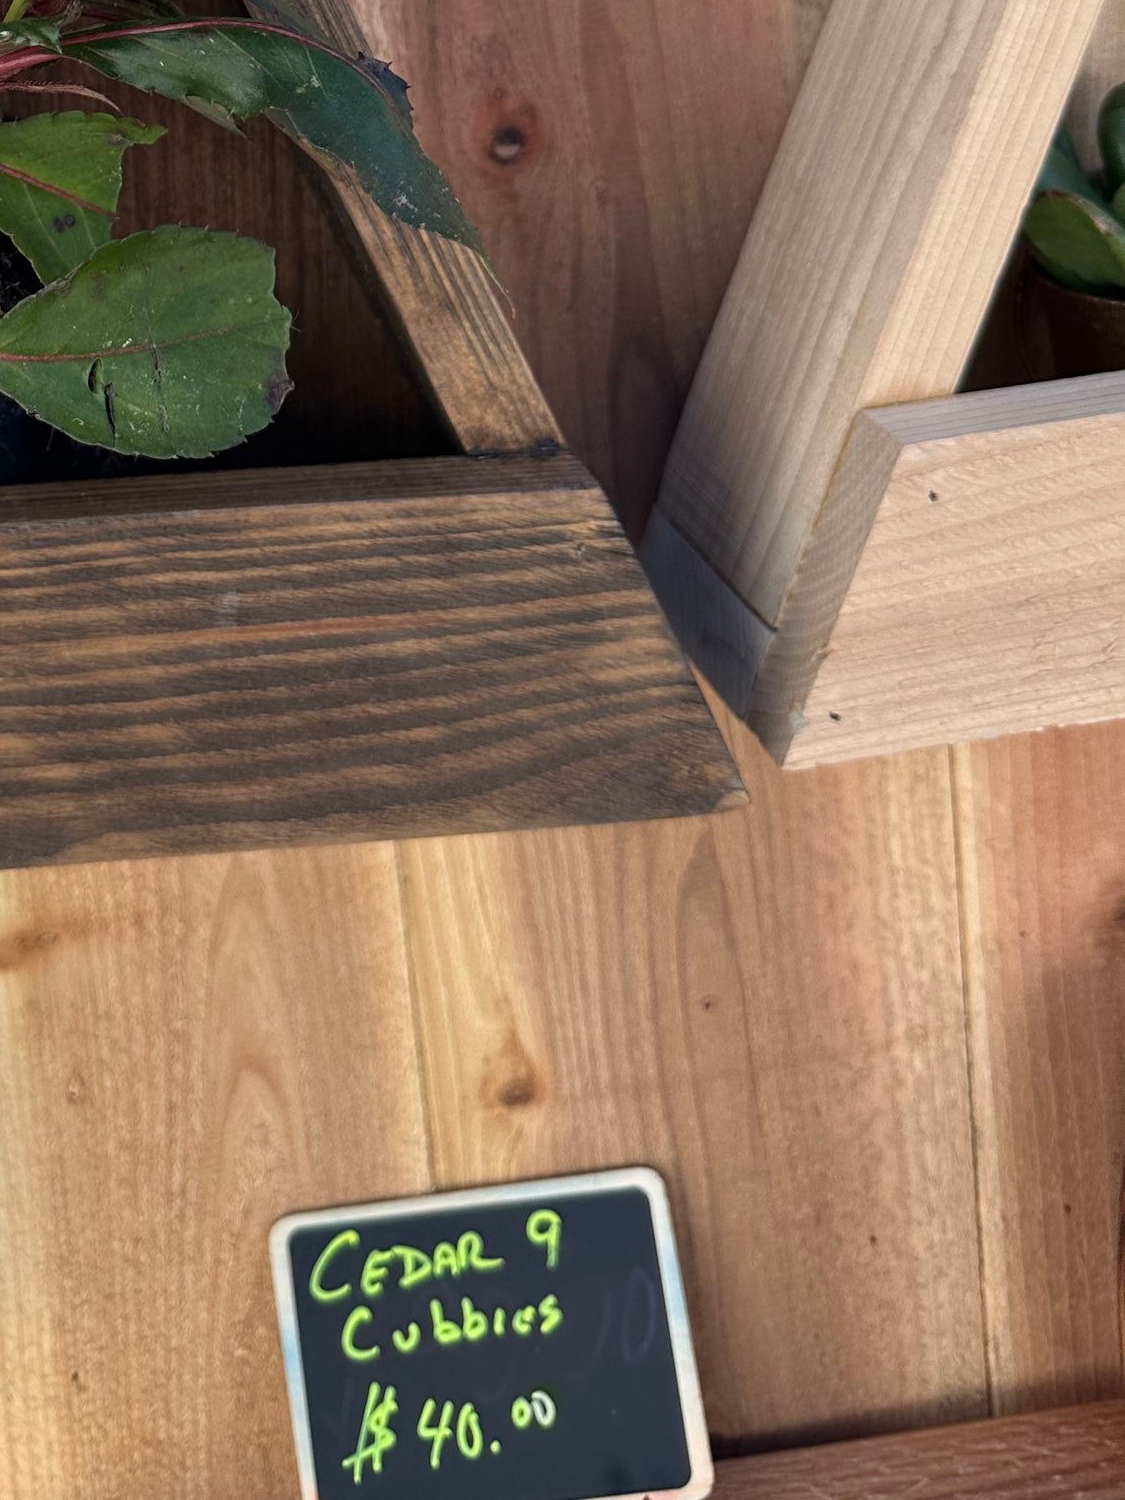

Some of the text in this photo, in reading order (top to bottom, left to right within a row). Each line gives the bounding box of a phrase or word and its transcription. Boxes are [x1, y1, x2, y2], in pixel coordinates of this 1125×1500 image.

[308, 1208, 563, 1302] CEDAR 9
[341, 1294, 564, 1362] Cubbies
